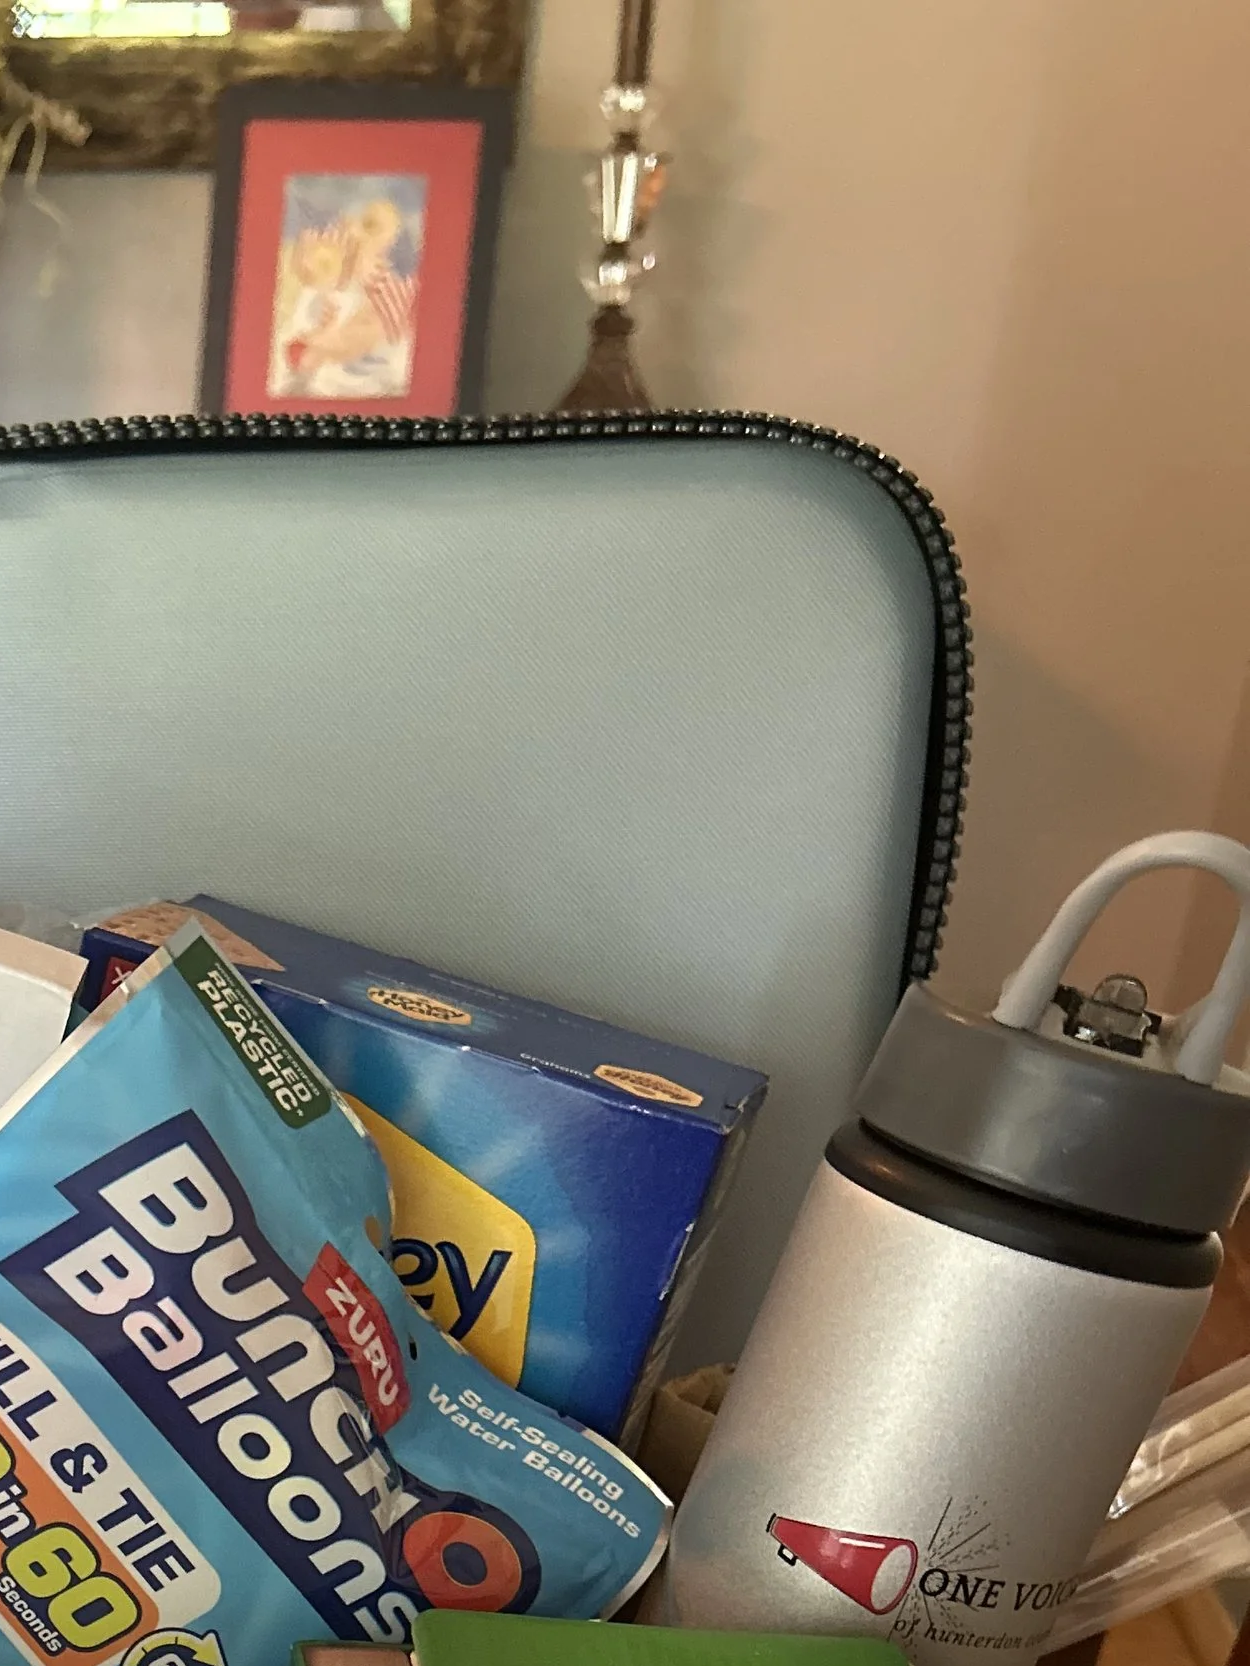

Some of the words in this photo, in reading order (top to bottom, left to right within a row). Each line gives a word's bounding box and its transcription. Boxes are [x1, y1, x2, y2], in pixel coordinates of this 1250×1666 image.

[207, 969, 313, 1103] RECYCLED
[326, 1277, 399, 1406] ZURU
[43, 1227, 419, 1643] Balloons
[428, 1383, 516, 1452] Water
[522, 1450, 641, 1540] Balloons
[458, 1389, 624, 1502] Self-Sealing
[50, 1443, 108, 1494] &
[97, 1488, 196, 1593] TIE
[4, 1525, 140, 1650] 60
[919, 1568, 1003, 1611] ONE
[922, 1622, 1023, 1650] hunterdon
